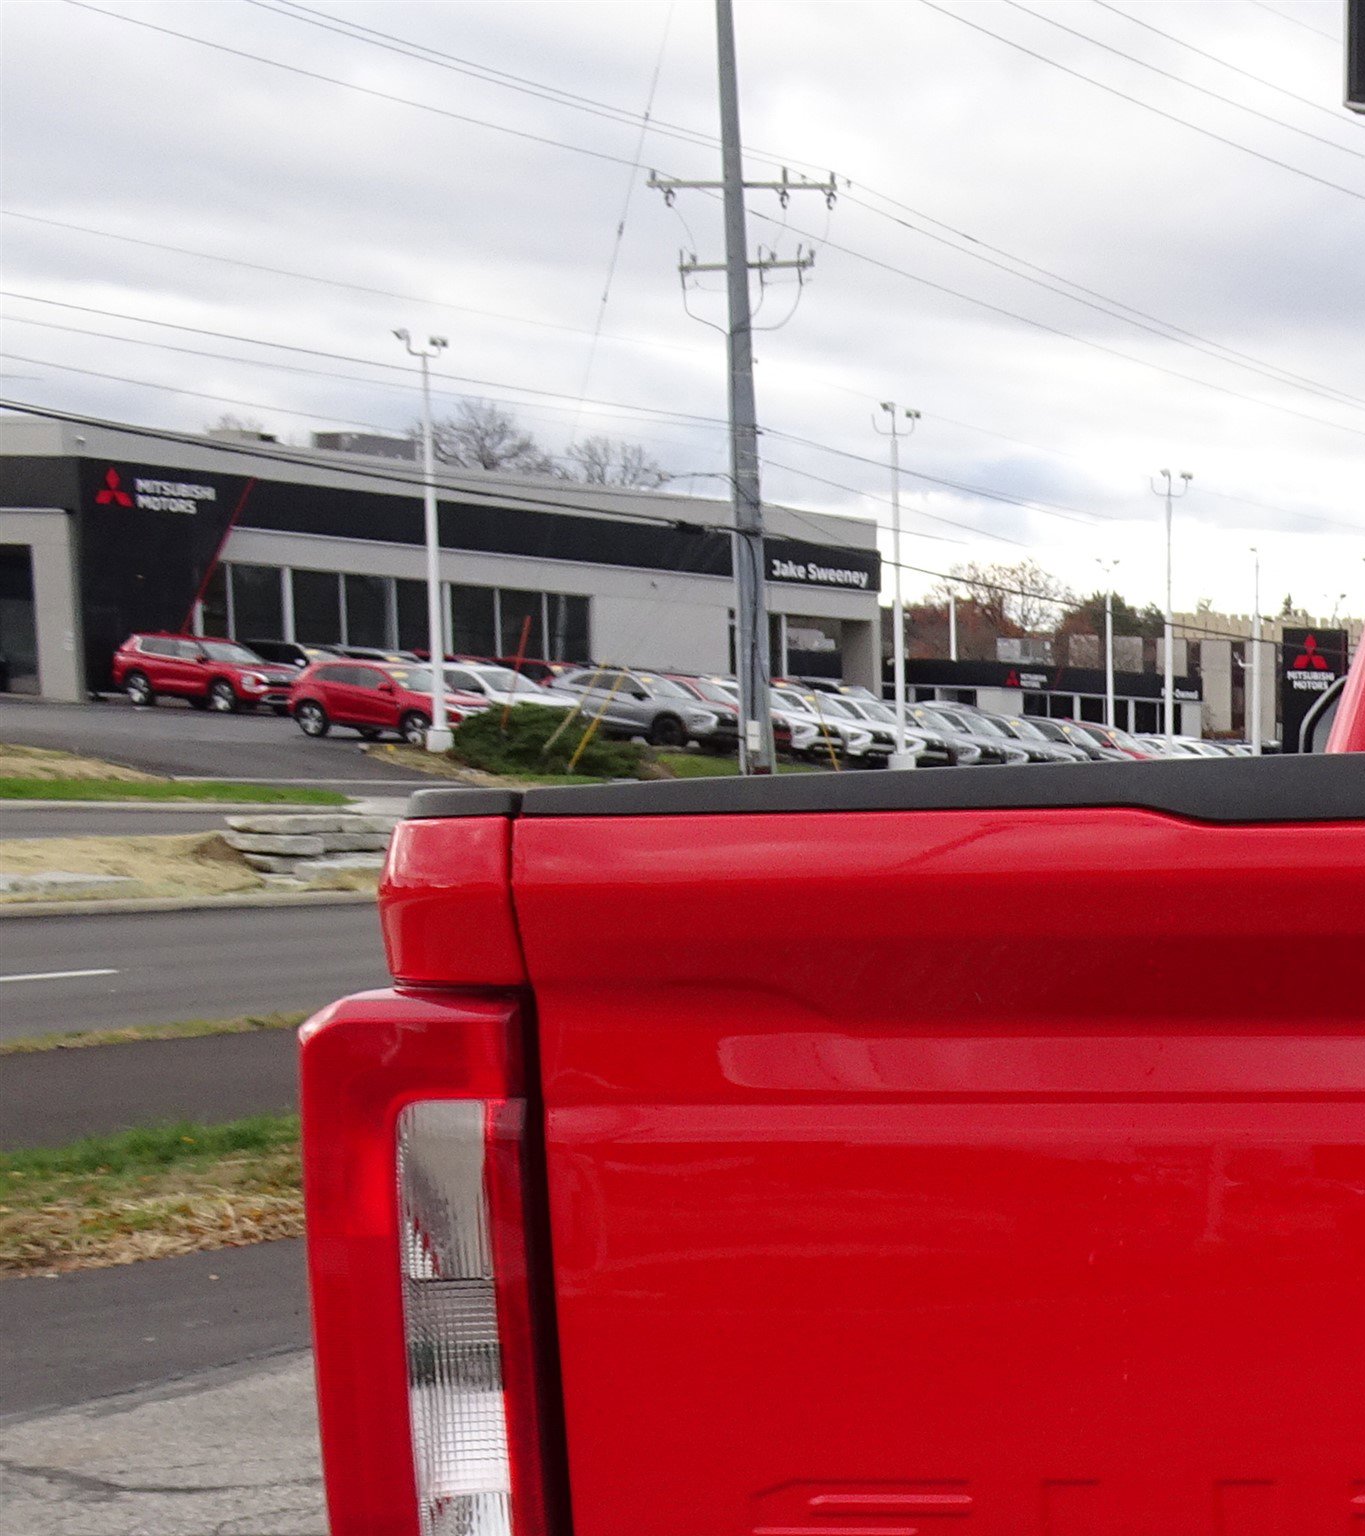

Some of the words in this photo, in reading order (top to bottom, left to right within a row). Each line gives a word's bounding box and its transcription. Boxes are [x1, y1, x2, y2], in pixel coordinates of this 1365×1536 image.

[136, 479, 216, 500] MITSUBISHI
[137, 495, 197, 514] MOTORS
[772, 559, 806, 579] Jake
[808, 563, 868, 588] Sweeney
[1287, 671, 1335, 681] MITSUBISHI
[1293, 680, 1329, 691] MOTORS
